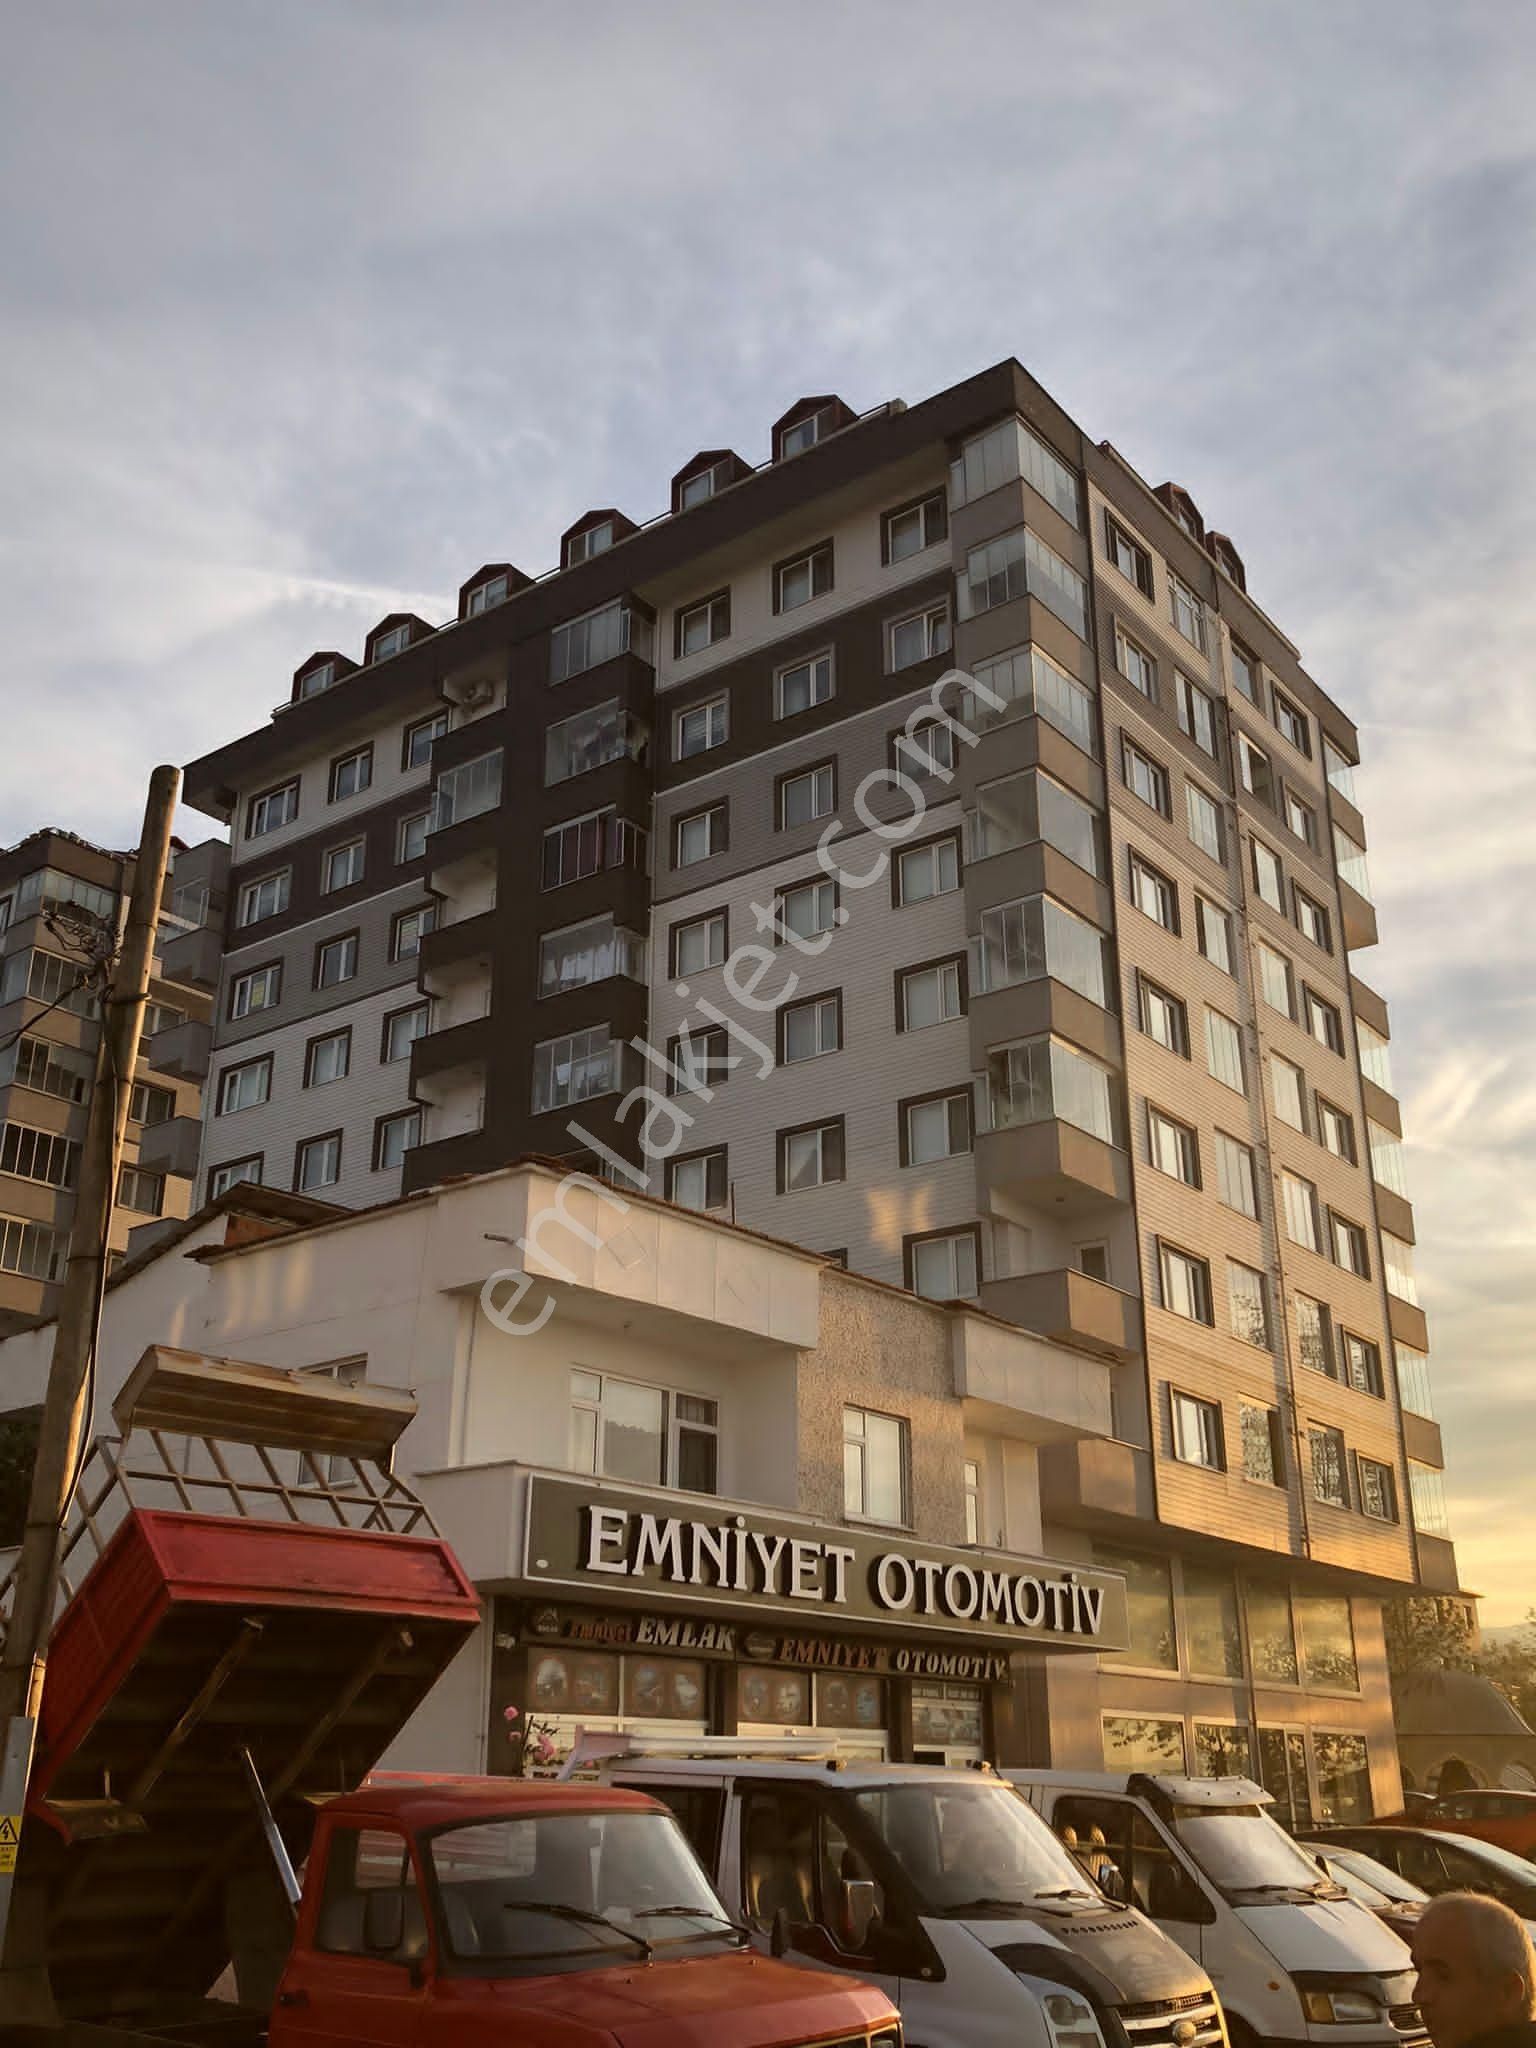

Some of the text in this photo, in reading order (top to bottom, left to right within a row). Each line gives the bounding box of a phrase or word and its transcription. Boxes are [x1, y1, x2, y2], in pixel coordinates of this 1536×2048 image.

[586, 1505, 1104, 1634] EMNİYET OTOMOTİV
[634, 1616, 737, 1651] EMLAK
